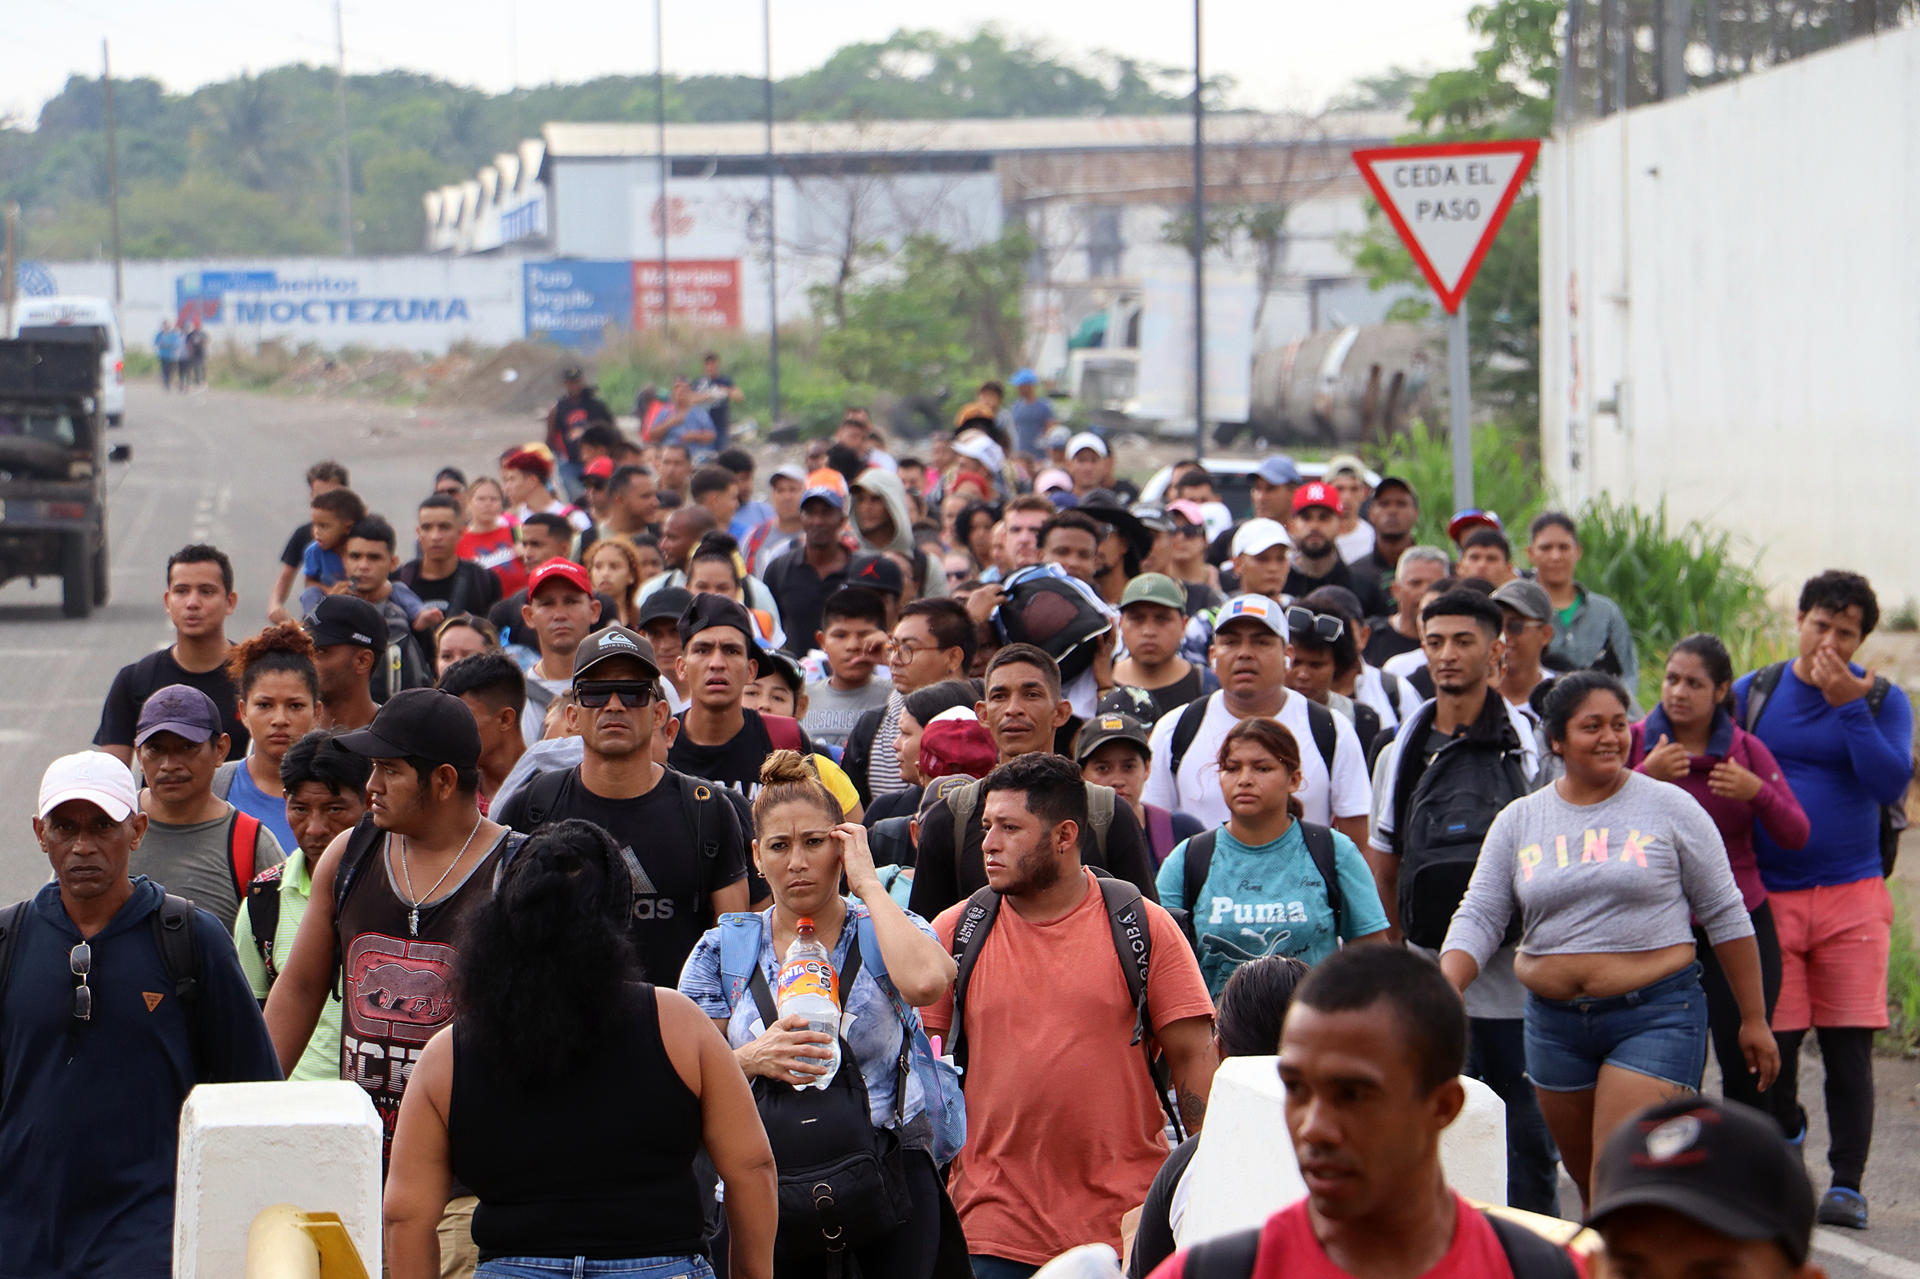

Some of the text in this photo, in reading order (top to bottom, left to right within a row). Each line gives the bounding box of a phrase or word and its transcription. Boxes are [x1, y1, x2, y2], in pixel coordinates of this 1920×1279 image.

[1393, 161, 1496, 188] CEDA EL
[1416, 197, 1481, 222] PASO
[237, 298, 469, 324] MOCTEZUMA
[1518, 828, 1655, 882] PINK
[1209, 896, 1308, 924] Puma
